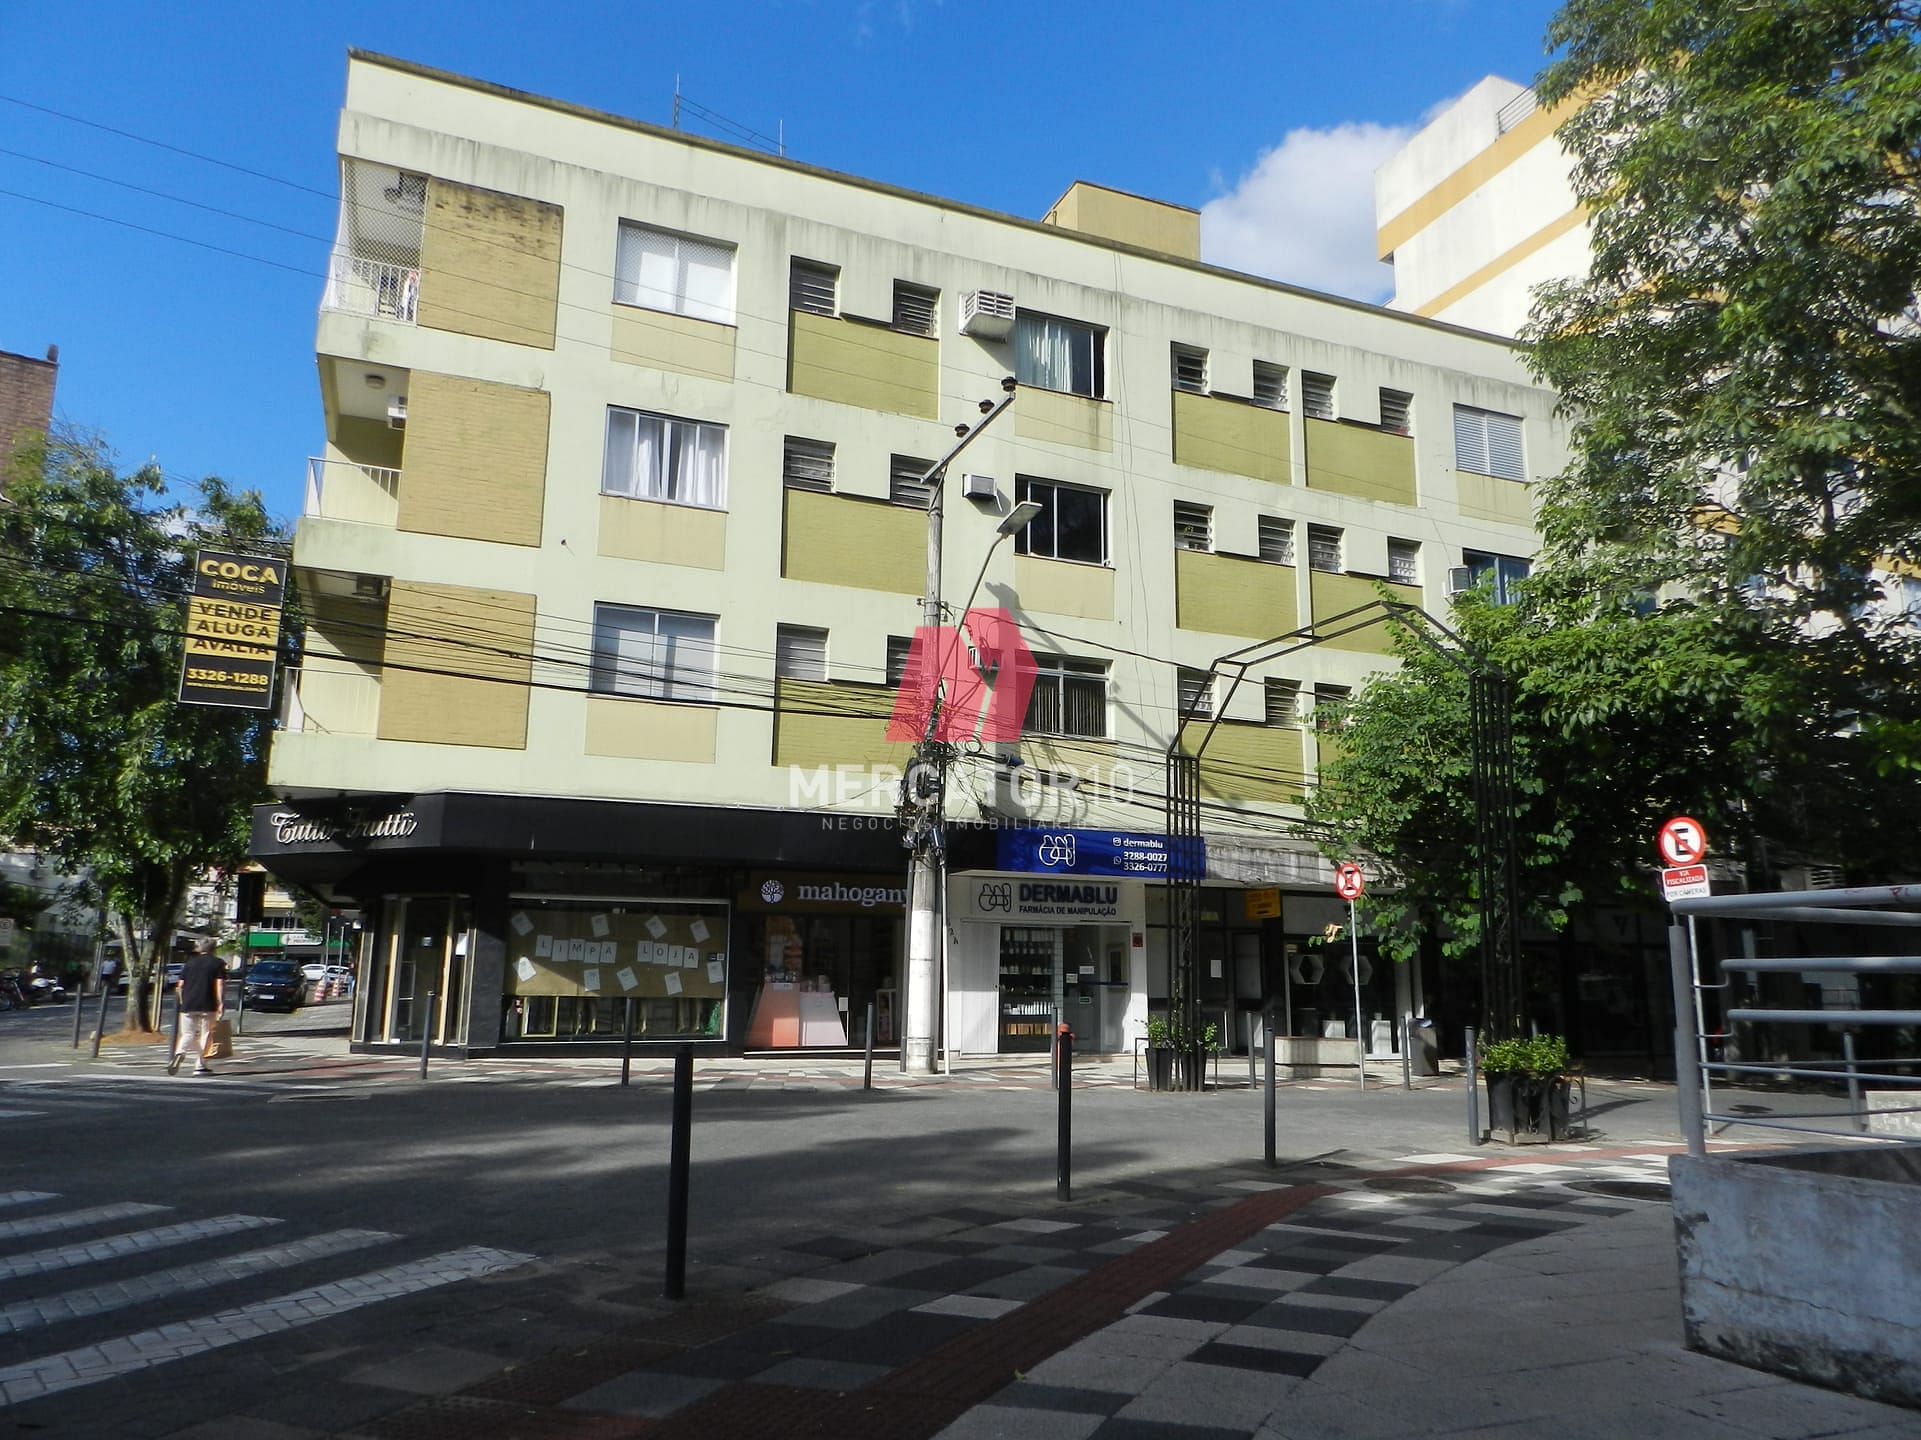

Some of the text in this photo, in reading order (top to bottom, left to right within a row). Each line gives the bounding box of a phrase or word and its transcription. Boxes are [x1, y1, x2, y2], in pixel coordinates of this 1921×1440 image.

[201, 559, 279, 585] COCA
[211, 580, 266, 594] imóveis
[199, 602, 273, 621] VENDE
[196, 619, 271, 639] ALUGA
[193, 637, 270, 656] AVALIA
[187, 667, 269, 685] 3326-1288
[1123, 838, 1163, 849] dermablu
[1123, 851, 1168, 862] 3288-0027
[1123, 862, 1168, 872] 3326-0777
[1667, 876, 1704, 885] FISCALIZADA
[1019, 883, 1118, 905] DERMABLU
[1019, 904, 1117, 917] FARMÁCIA DE MANIPULAÇÃO
